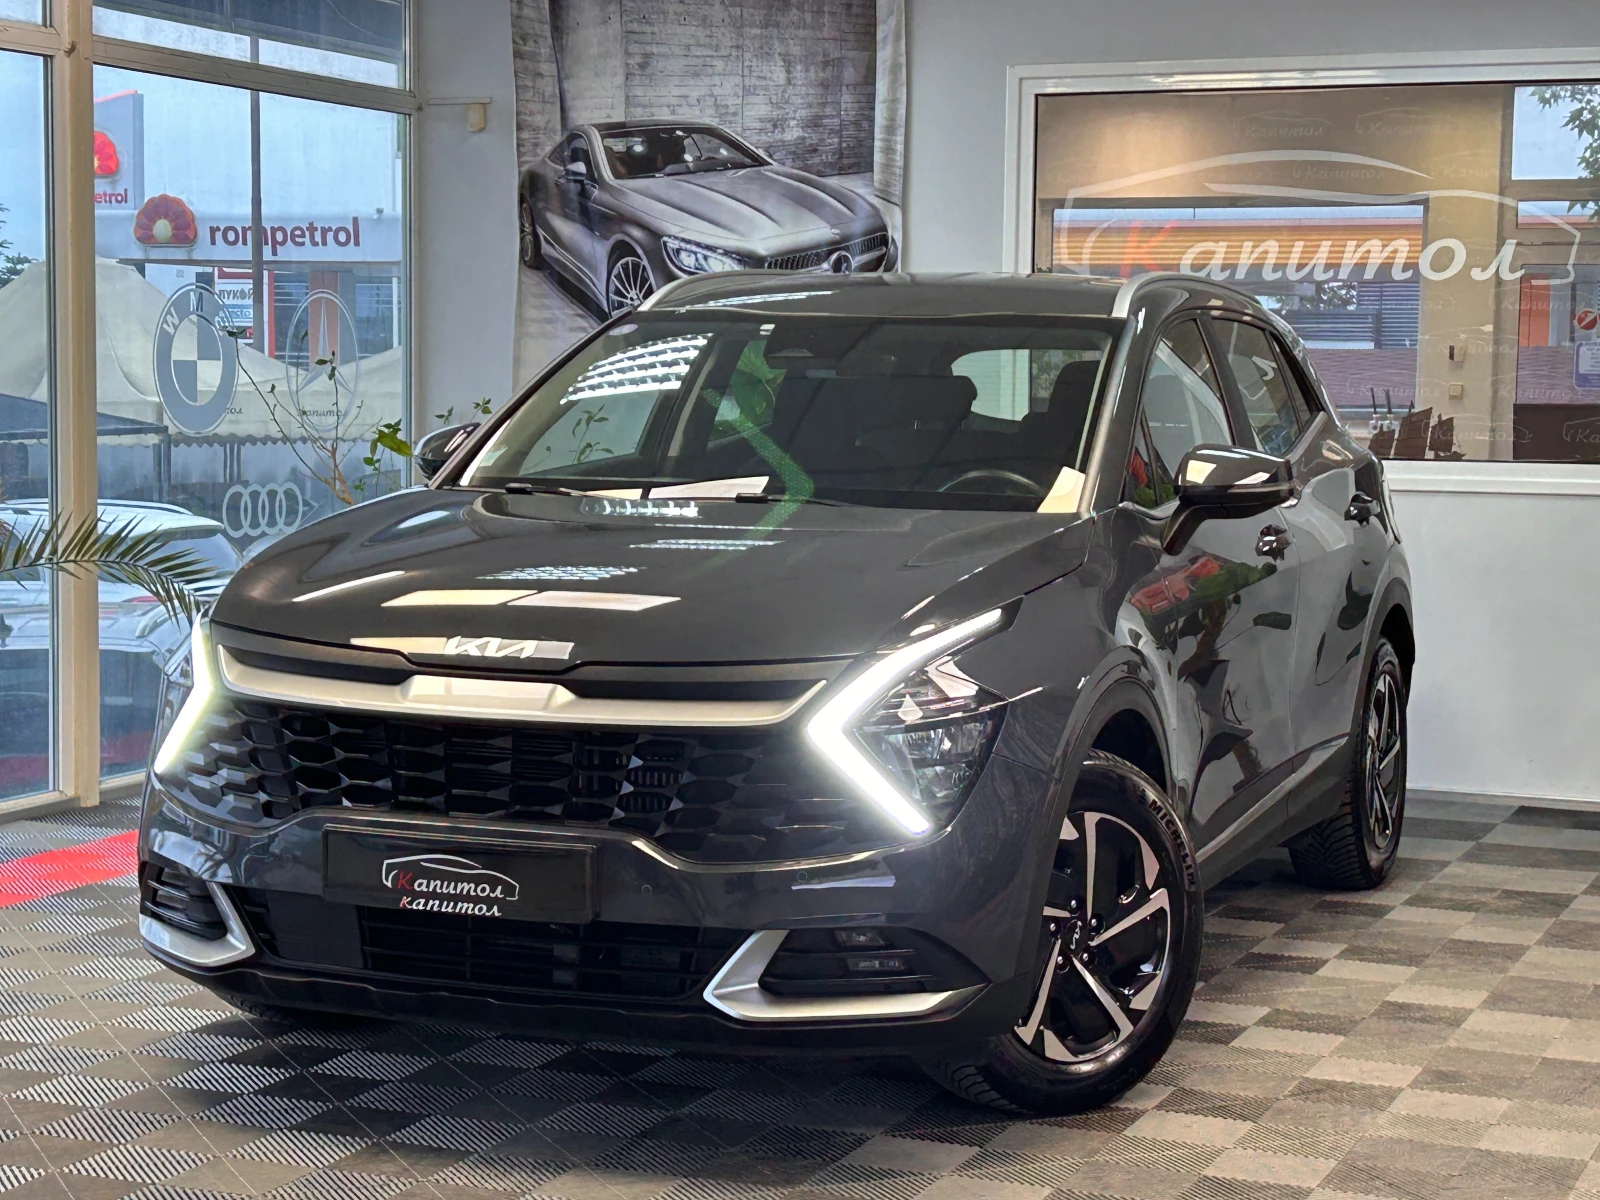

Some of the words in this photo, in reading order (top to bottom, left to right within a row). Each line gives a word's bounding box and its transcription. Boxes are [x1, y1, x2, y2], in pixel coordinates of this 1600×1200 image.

[94, 188, 128, 204] etrol
[209, 216, 360, 256] rompetrol
[1119, 220, 1525, 281] Капитол
[443, 636, 538, 659] KIA
[1149, 798, 1196, 887] MICHELIN
[397, 871, 504, 898] Капитол
